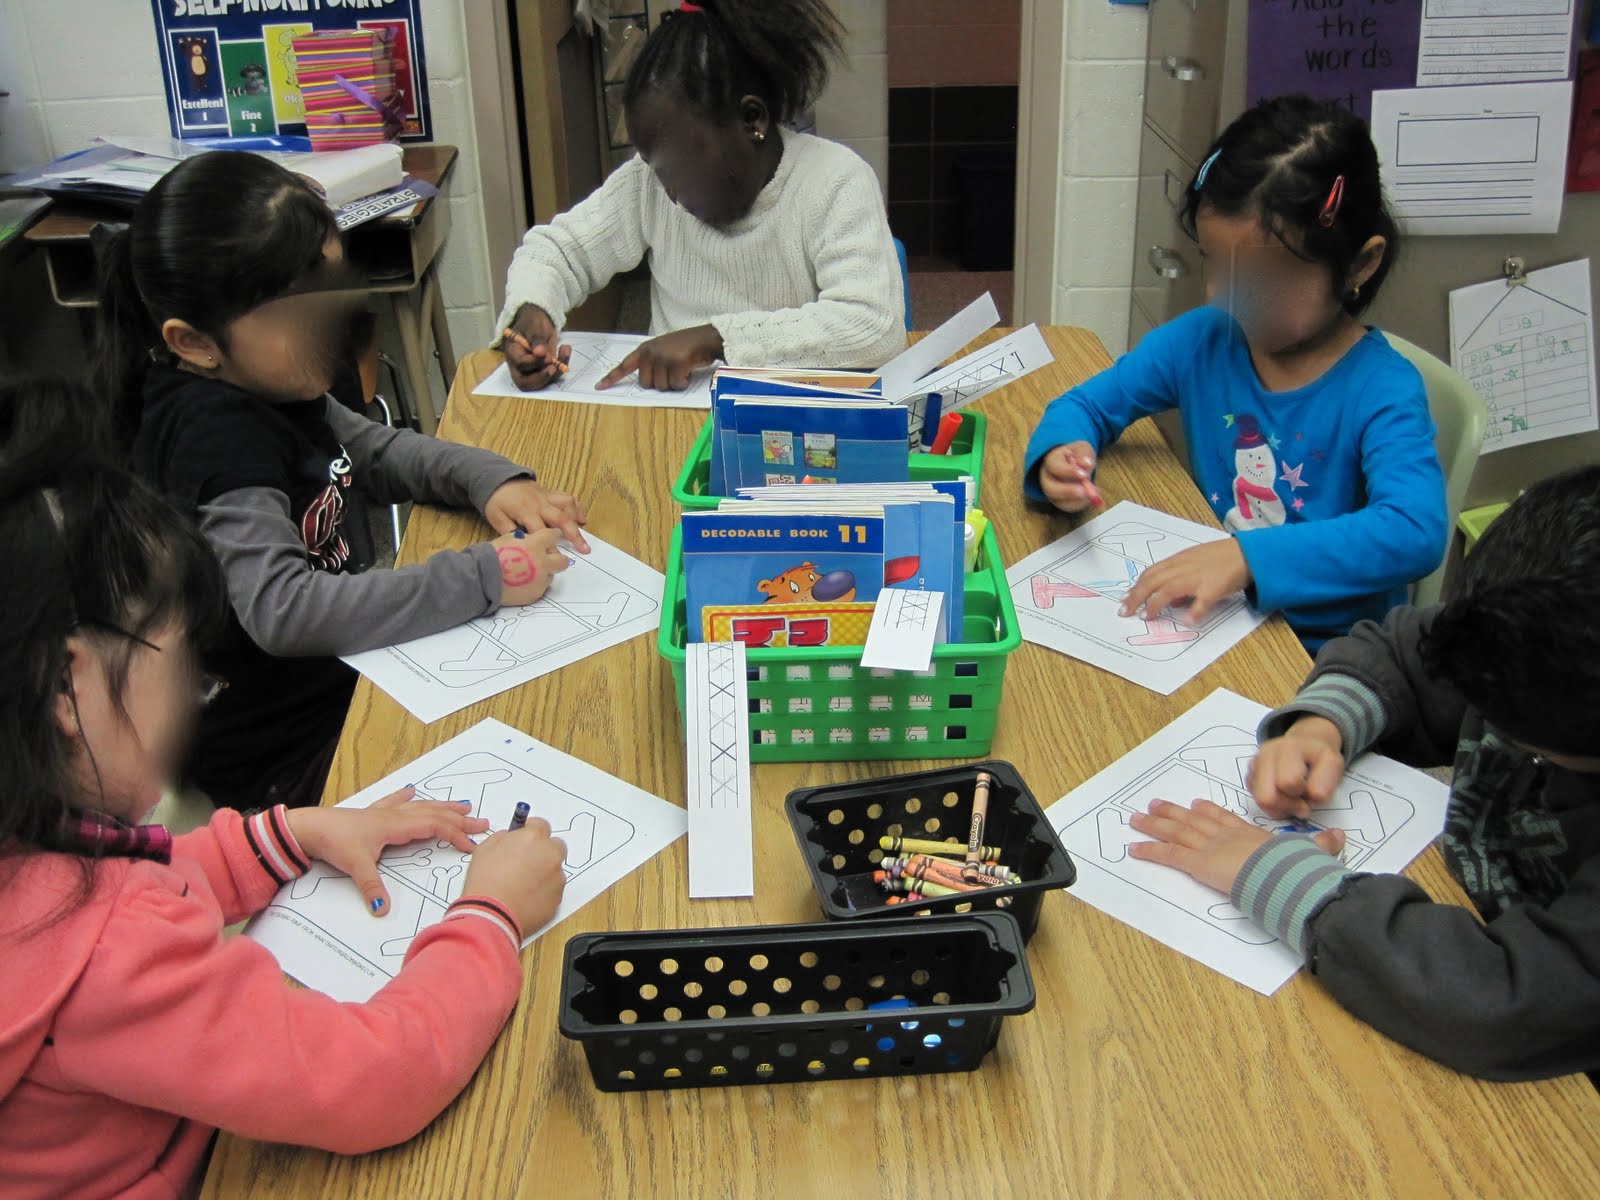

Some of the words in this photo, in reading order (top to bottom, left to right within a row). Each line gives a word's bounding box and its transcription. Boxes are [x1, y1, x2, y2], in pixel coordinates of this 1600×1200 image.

[1316, 14, 1377, 38] the
[1305, 41, 1393, 72] words
[182, 98, 224, 110] Excellent
[241, 110, 262, 121] Fine
[701, 529, 781, 538] DECODABLE
[790, 529, 828, 538] BOOK
[838, 525, 867, 544] 11
[969, 815, 981, 848] Crayola
